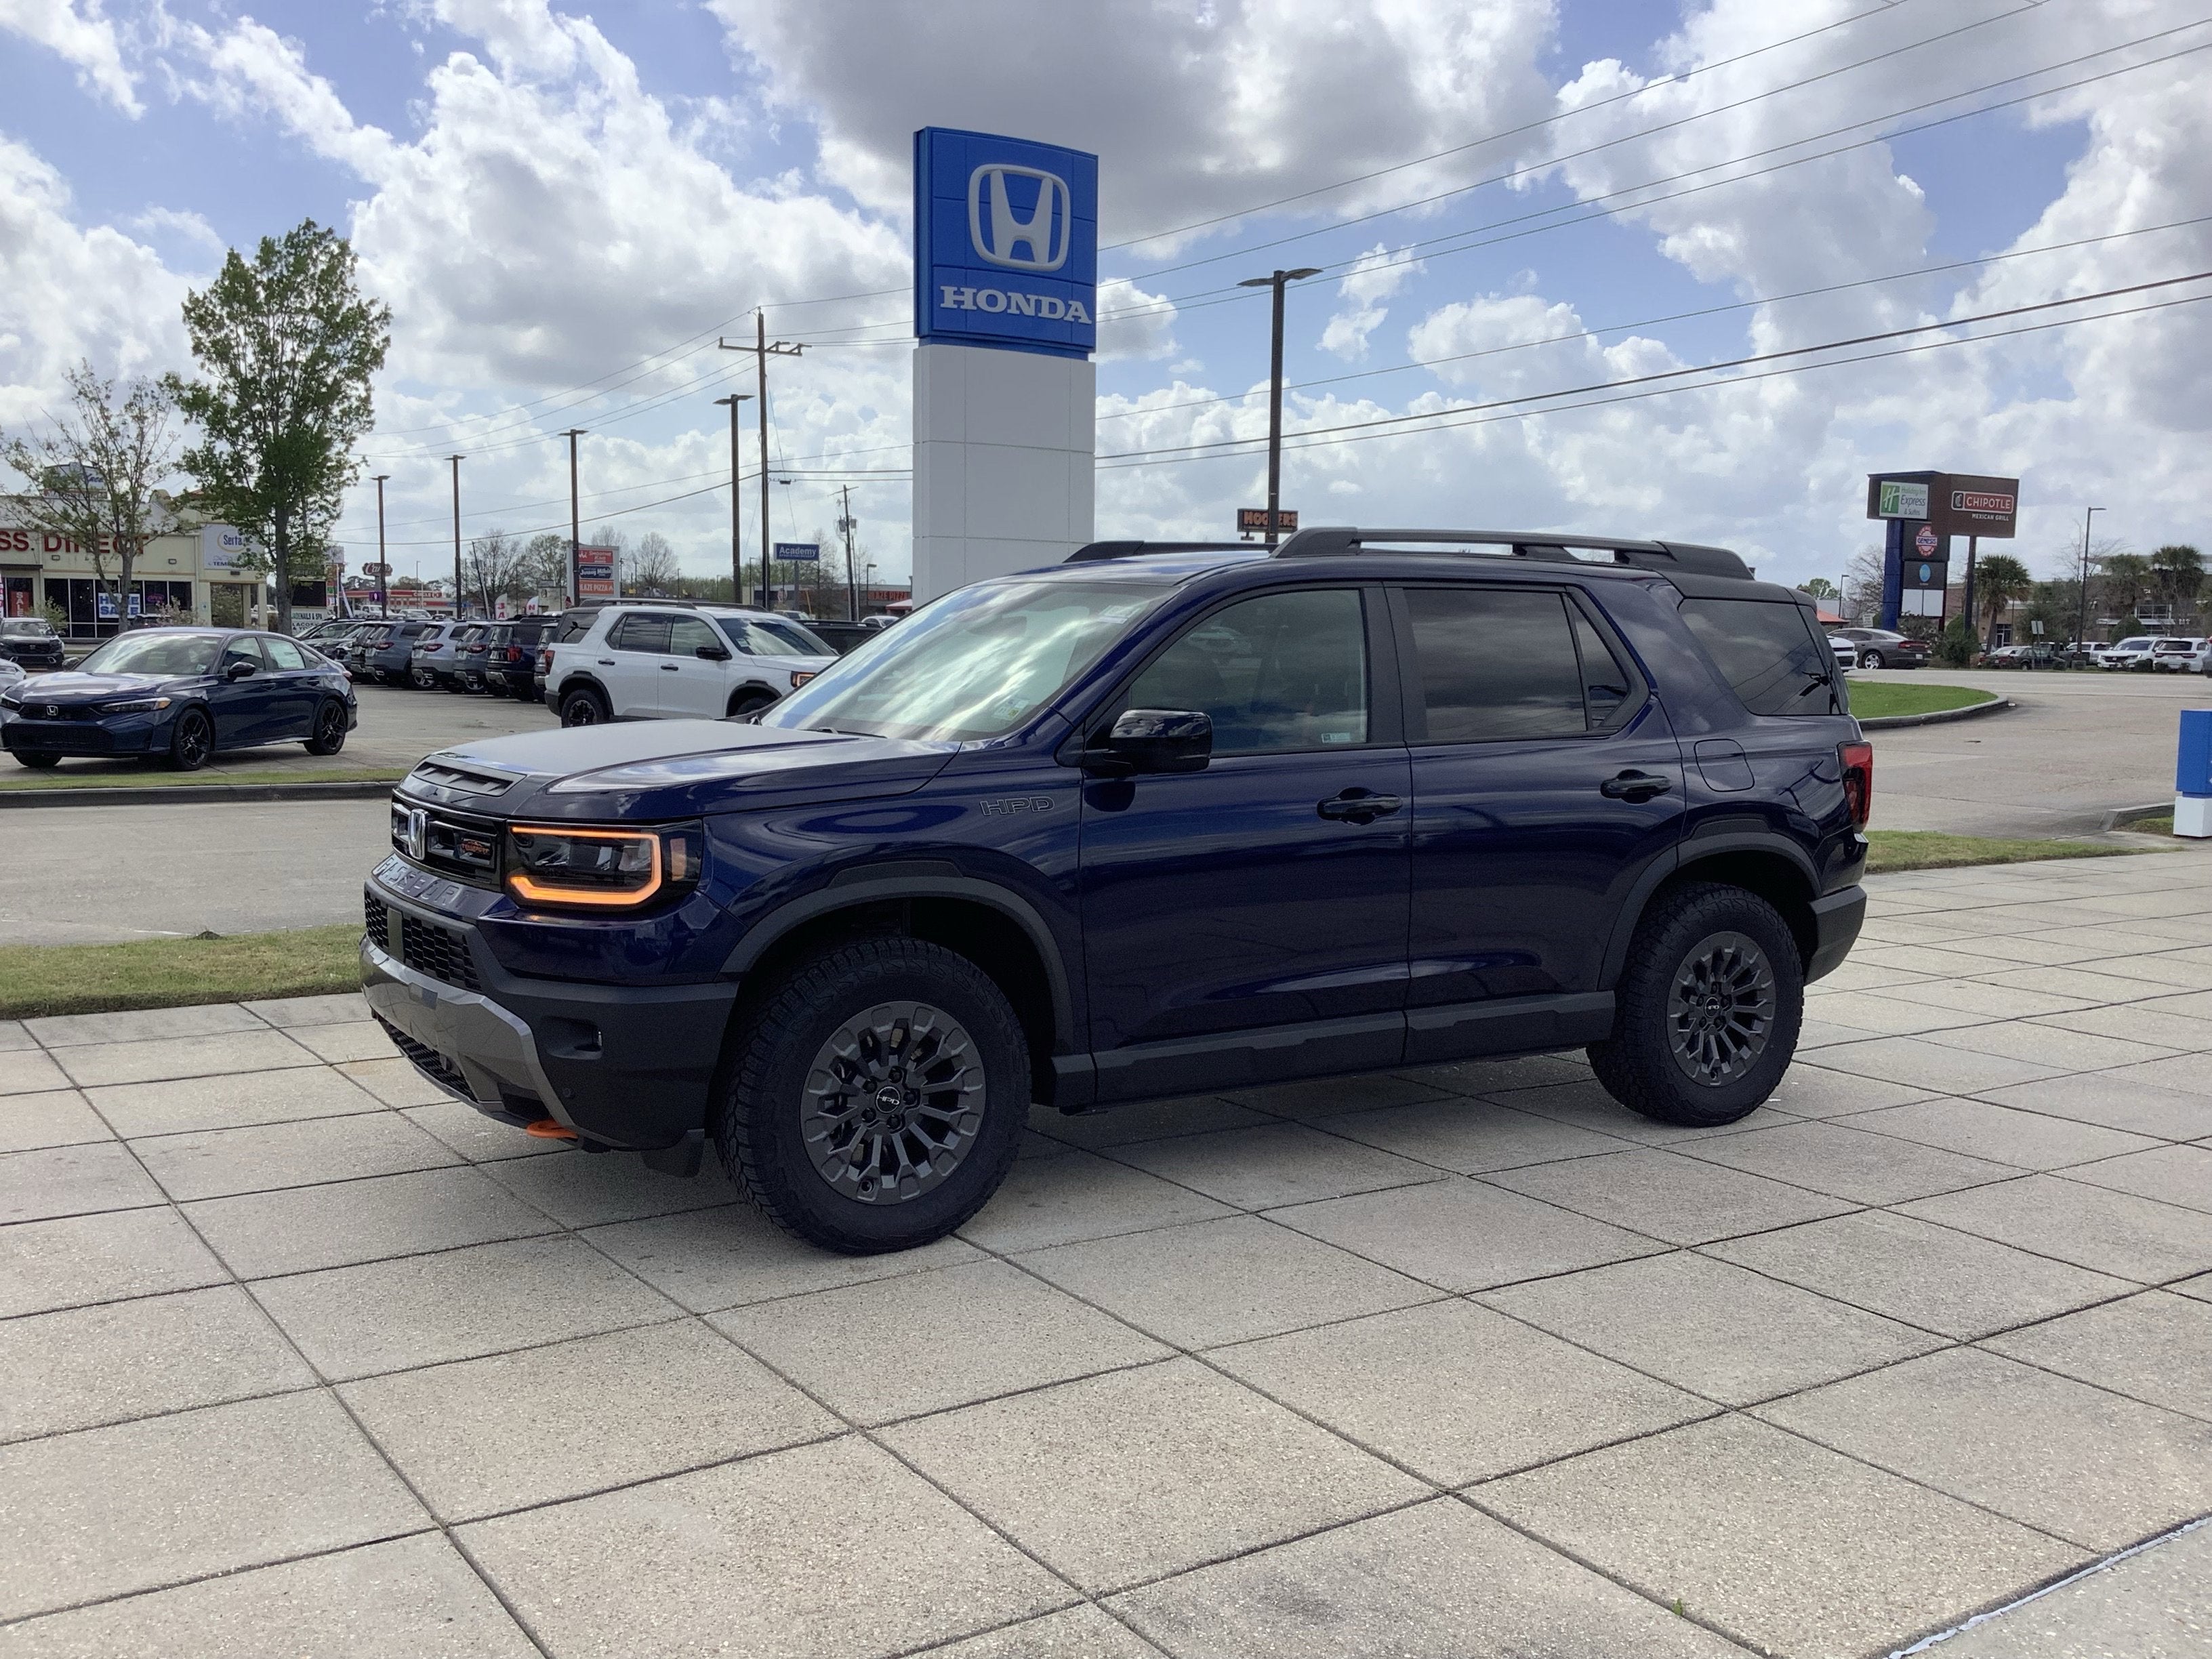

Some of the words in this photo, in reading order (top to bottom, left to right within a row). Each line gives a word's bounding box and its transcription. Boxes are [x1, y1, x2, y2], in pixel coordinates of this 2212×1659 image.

[939, 285, 1092, 325] HONDA
[1900, 495, 1926, 507] Express
[1966, 497, 2011, 509] CHIPOTLE
[1244, 511, 1298, 527] HOOERS
[223, 534, 243, 546] Serta
[779, 546, 817, 557] Academy
[980, 796, 1055, 816] HPD
[876, 1094, 900, 1105] HPD
